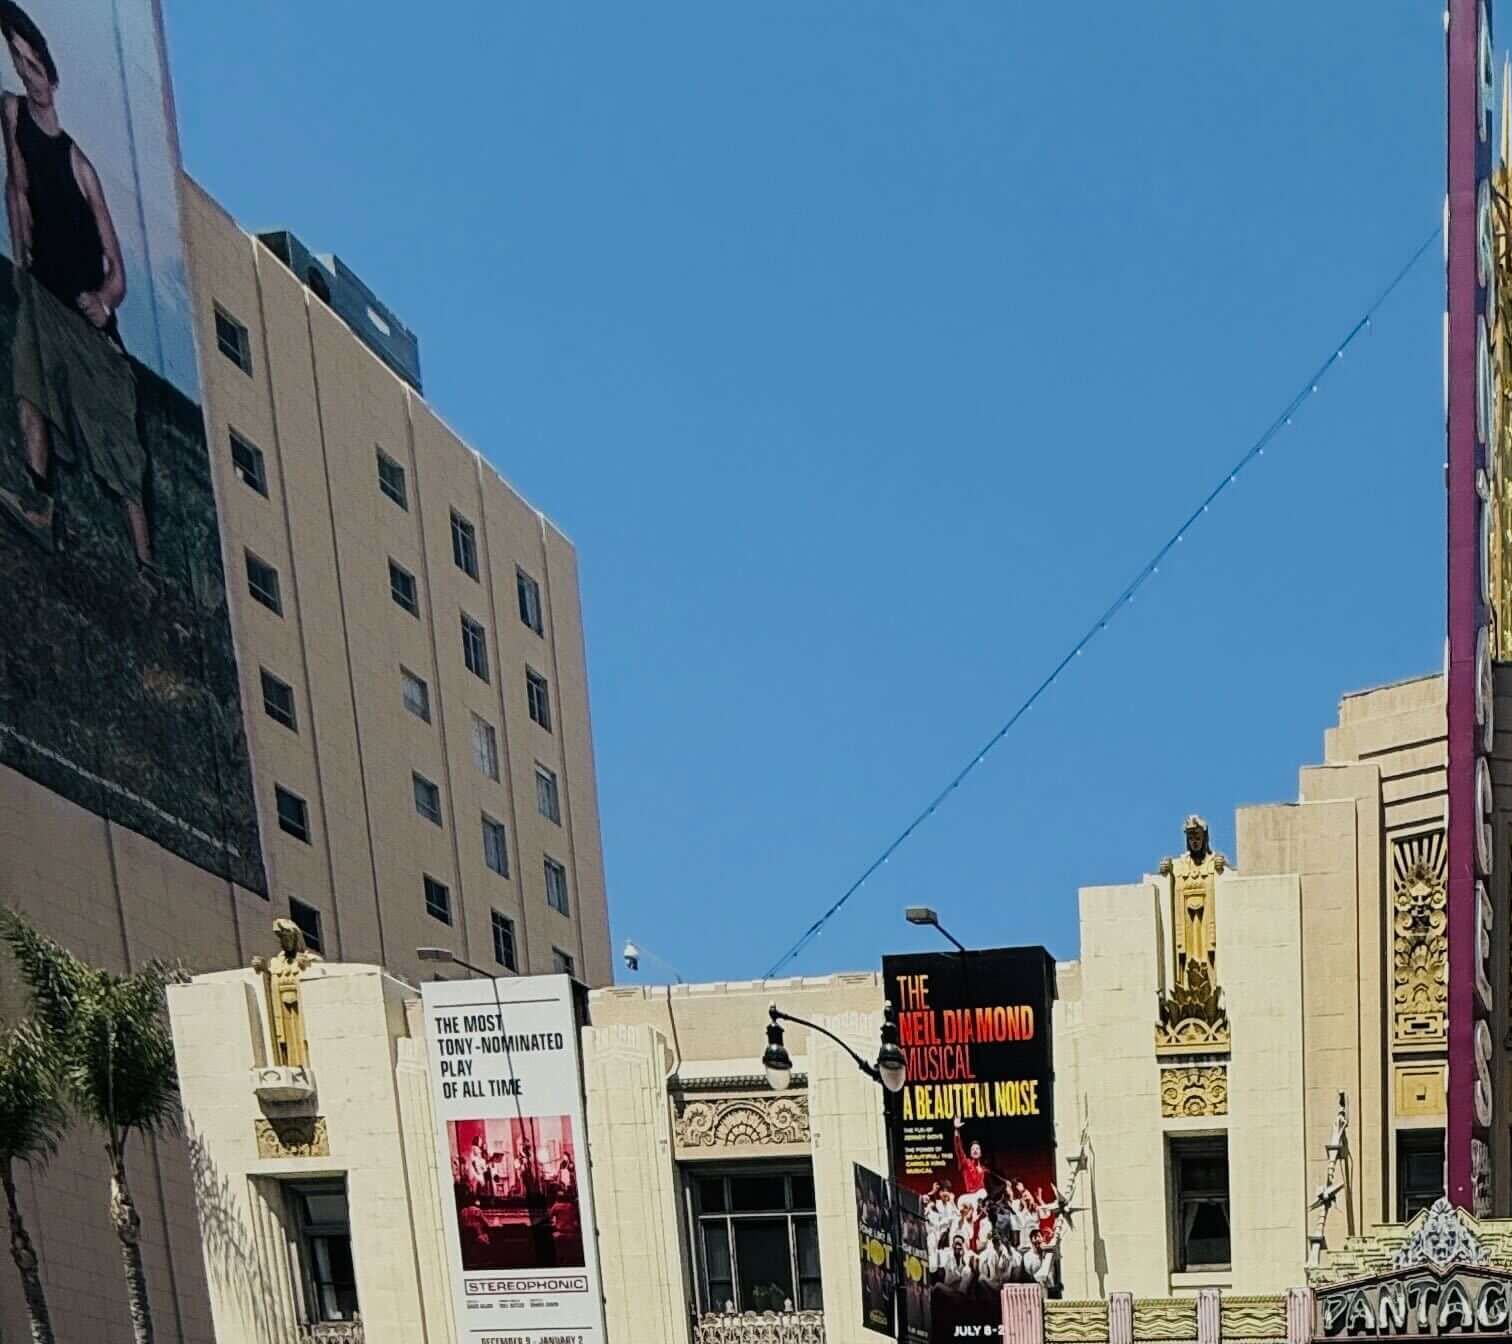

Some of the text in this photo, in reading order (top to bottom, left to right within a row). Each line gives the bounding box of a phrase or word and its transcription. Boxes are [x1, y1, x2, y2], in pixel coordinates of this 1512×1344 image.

[896, 975, 930, 1010] THE
[435, 1014, 502, 1034] THE MOST
[899, 1005, 1035, 1046] NEIL DIAMOND
[438, 1032, 563, 1056] TONY-NOMINATED
[441, 1060, 472, 1077] PLAY
[902, 1045, 976, 1081] MUSICAL
[443, 1078, 523, 1099] OF ALL TIME
[903, 1079, 1040, 1121] A BEAUTIFUL NOISE
[469, 1280, 583, 1292] STEREOPHONIC
[578, 1336, 583, 1344] 2
[954, 1326, 980, 1337] JULY
